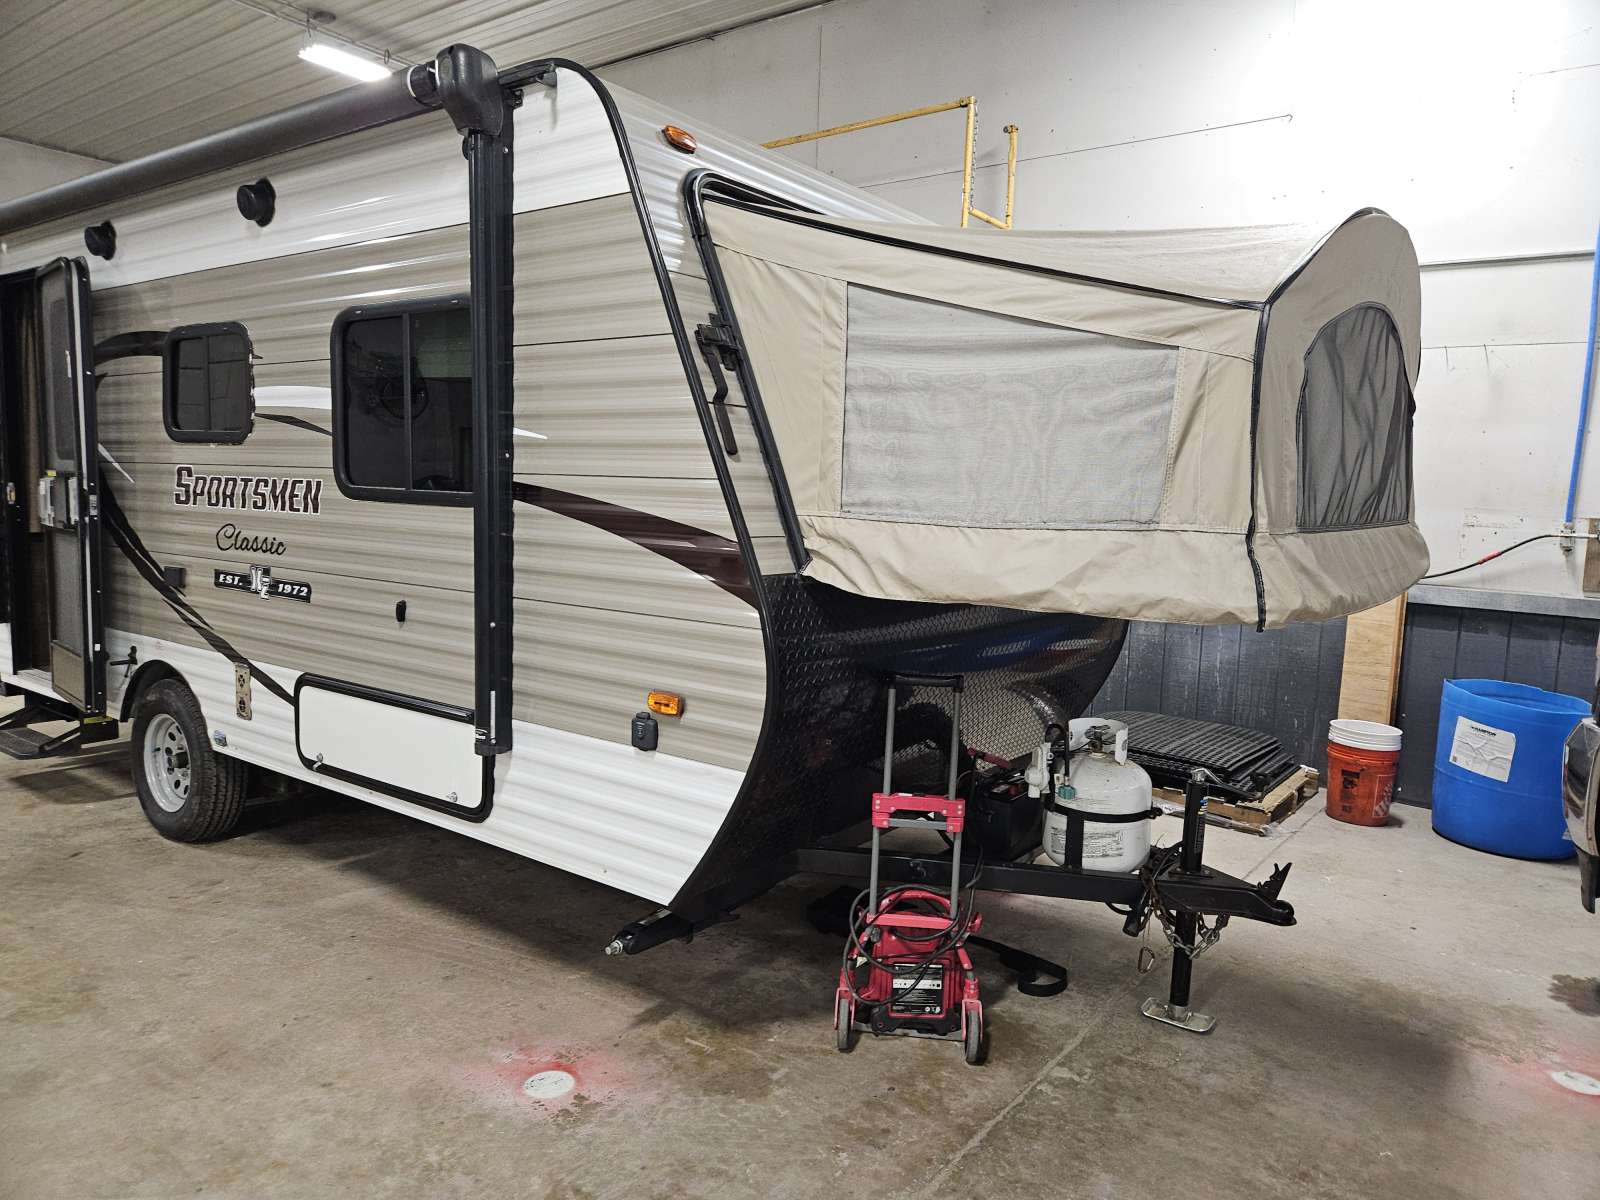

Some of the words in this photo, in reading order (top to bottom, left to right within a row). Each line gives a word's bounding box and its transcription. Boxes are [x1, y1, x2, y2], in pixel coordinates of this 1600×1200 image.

[174, 465, 323, 514] SPORTSMEN
[216, 523, 287, 555] Classic
[219, 574, 242, 586] EST.
[277, 583, 308, 596] 1972
